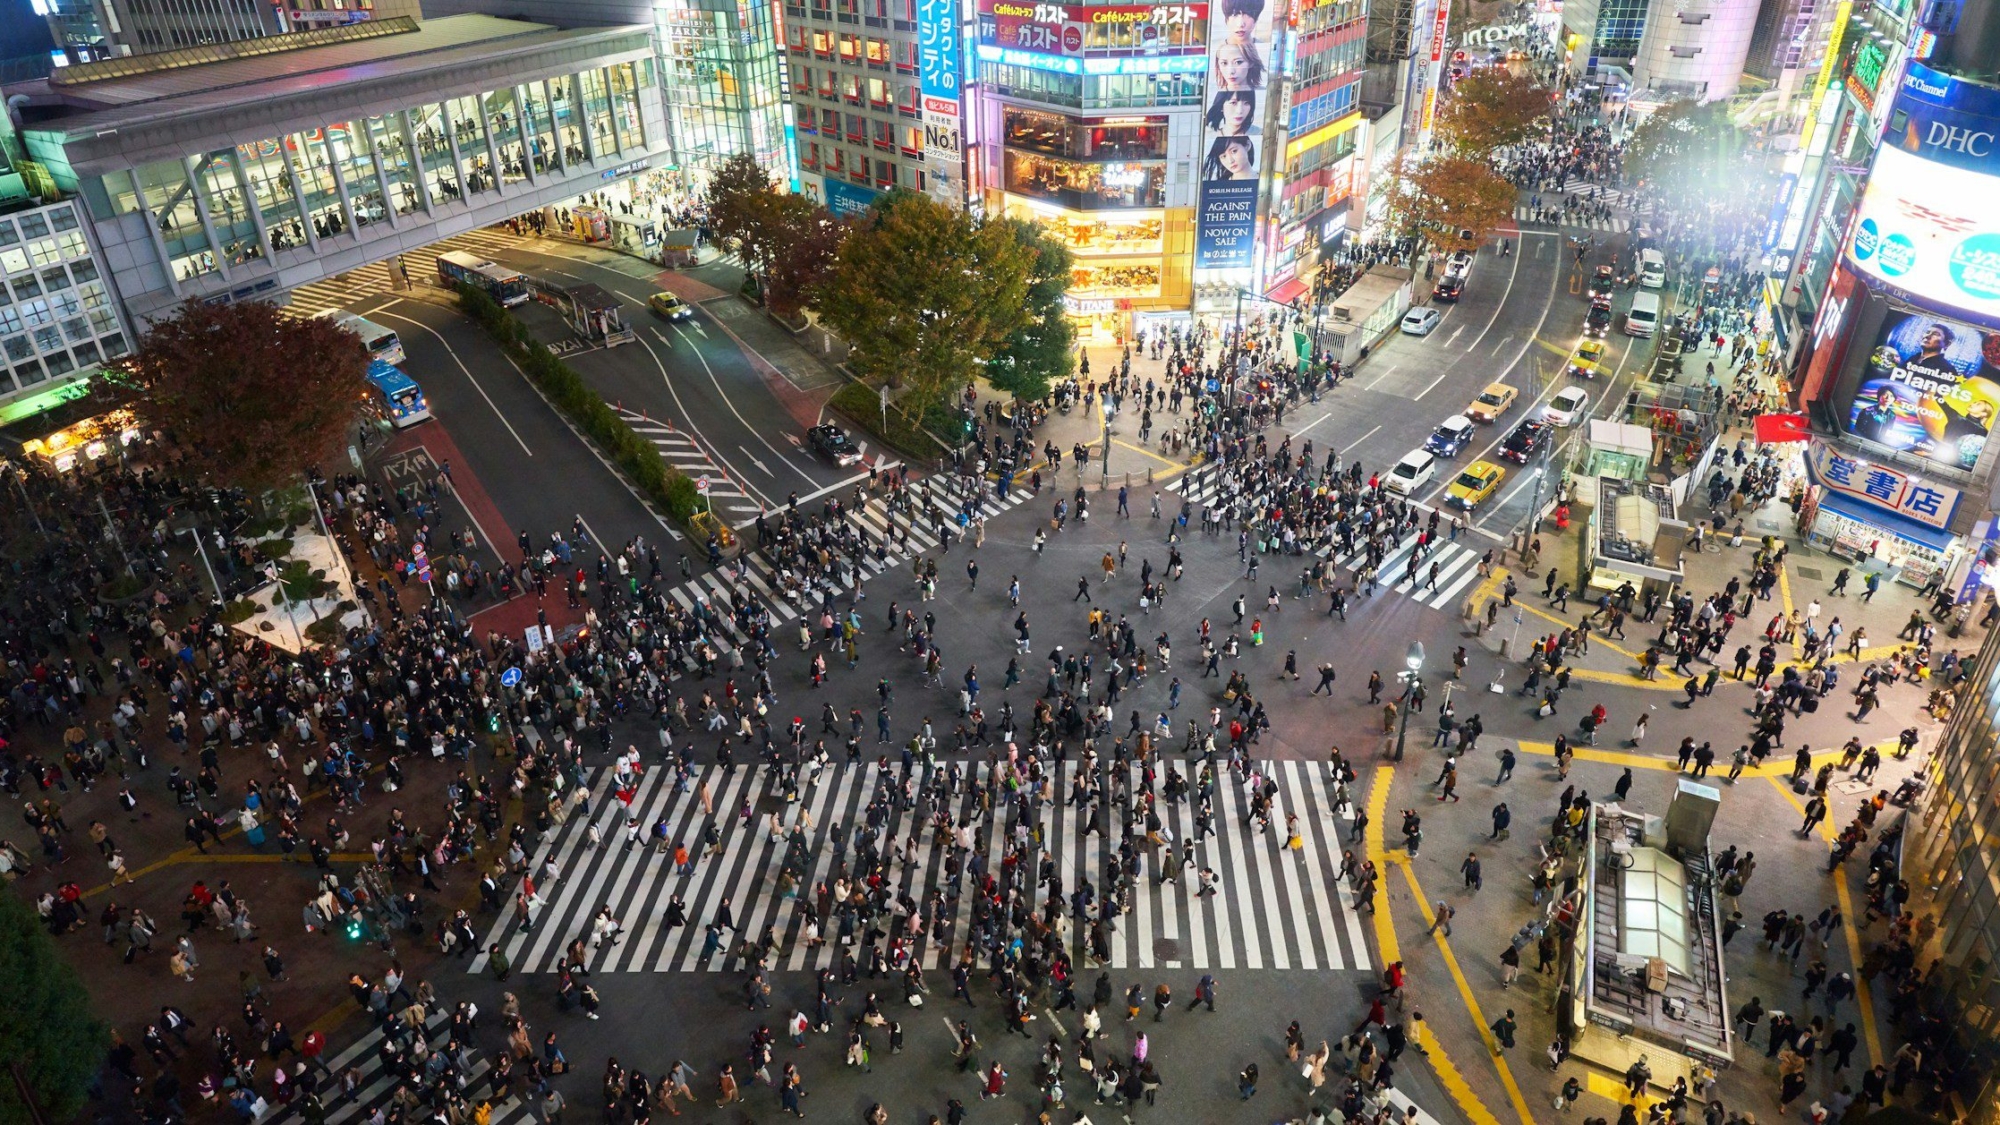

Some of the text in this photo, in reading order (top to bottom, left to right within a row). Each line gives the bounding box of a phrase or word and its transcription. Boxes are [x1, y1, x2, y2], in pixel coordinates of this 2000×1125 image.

[1034, 4, 1069, 24] ガスト
[1152, 6, 1198, 24] ガスト
[705, 28, 737, 38] CTY
[981, 22, 996, 37] 7F
[1018, 24, 1058, 49] ガスト
[1065, 37, 1080, 45] ガスト
[1903, 74, 1948, 98] DHC Channel
[925, 124, 959, 152] No.1
[1925, 121, 1995, 157] DHC
[1205, 213, 1225, 222] THE
[1205, 228, 1248, 237] NOW ON
[1215, 237, 1237, 246] SALE
[1906, 361, 1956, 382] teamLab
[1890, 367, 1973, 402] Planets
[1911, 389, 1945, 404] TOKYO
[1900, 402, 1944, 420] TOYOSU
